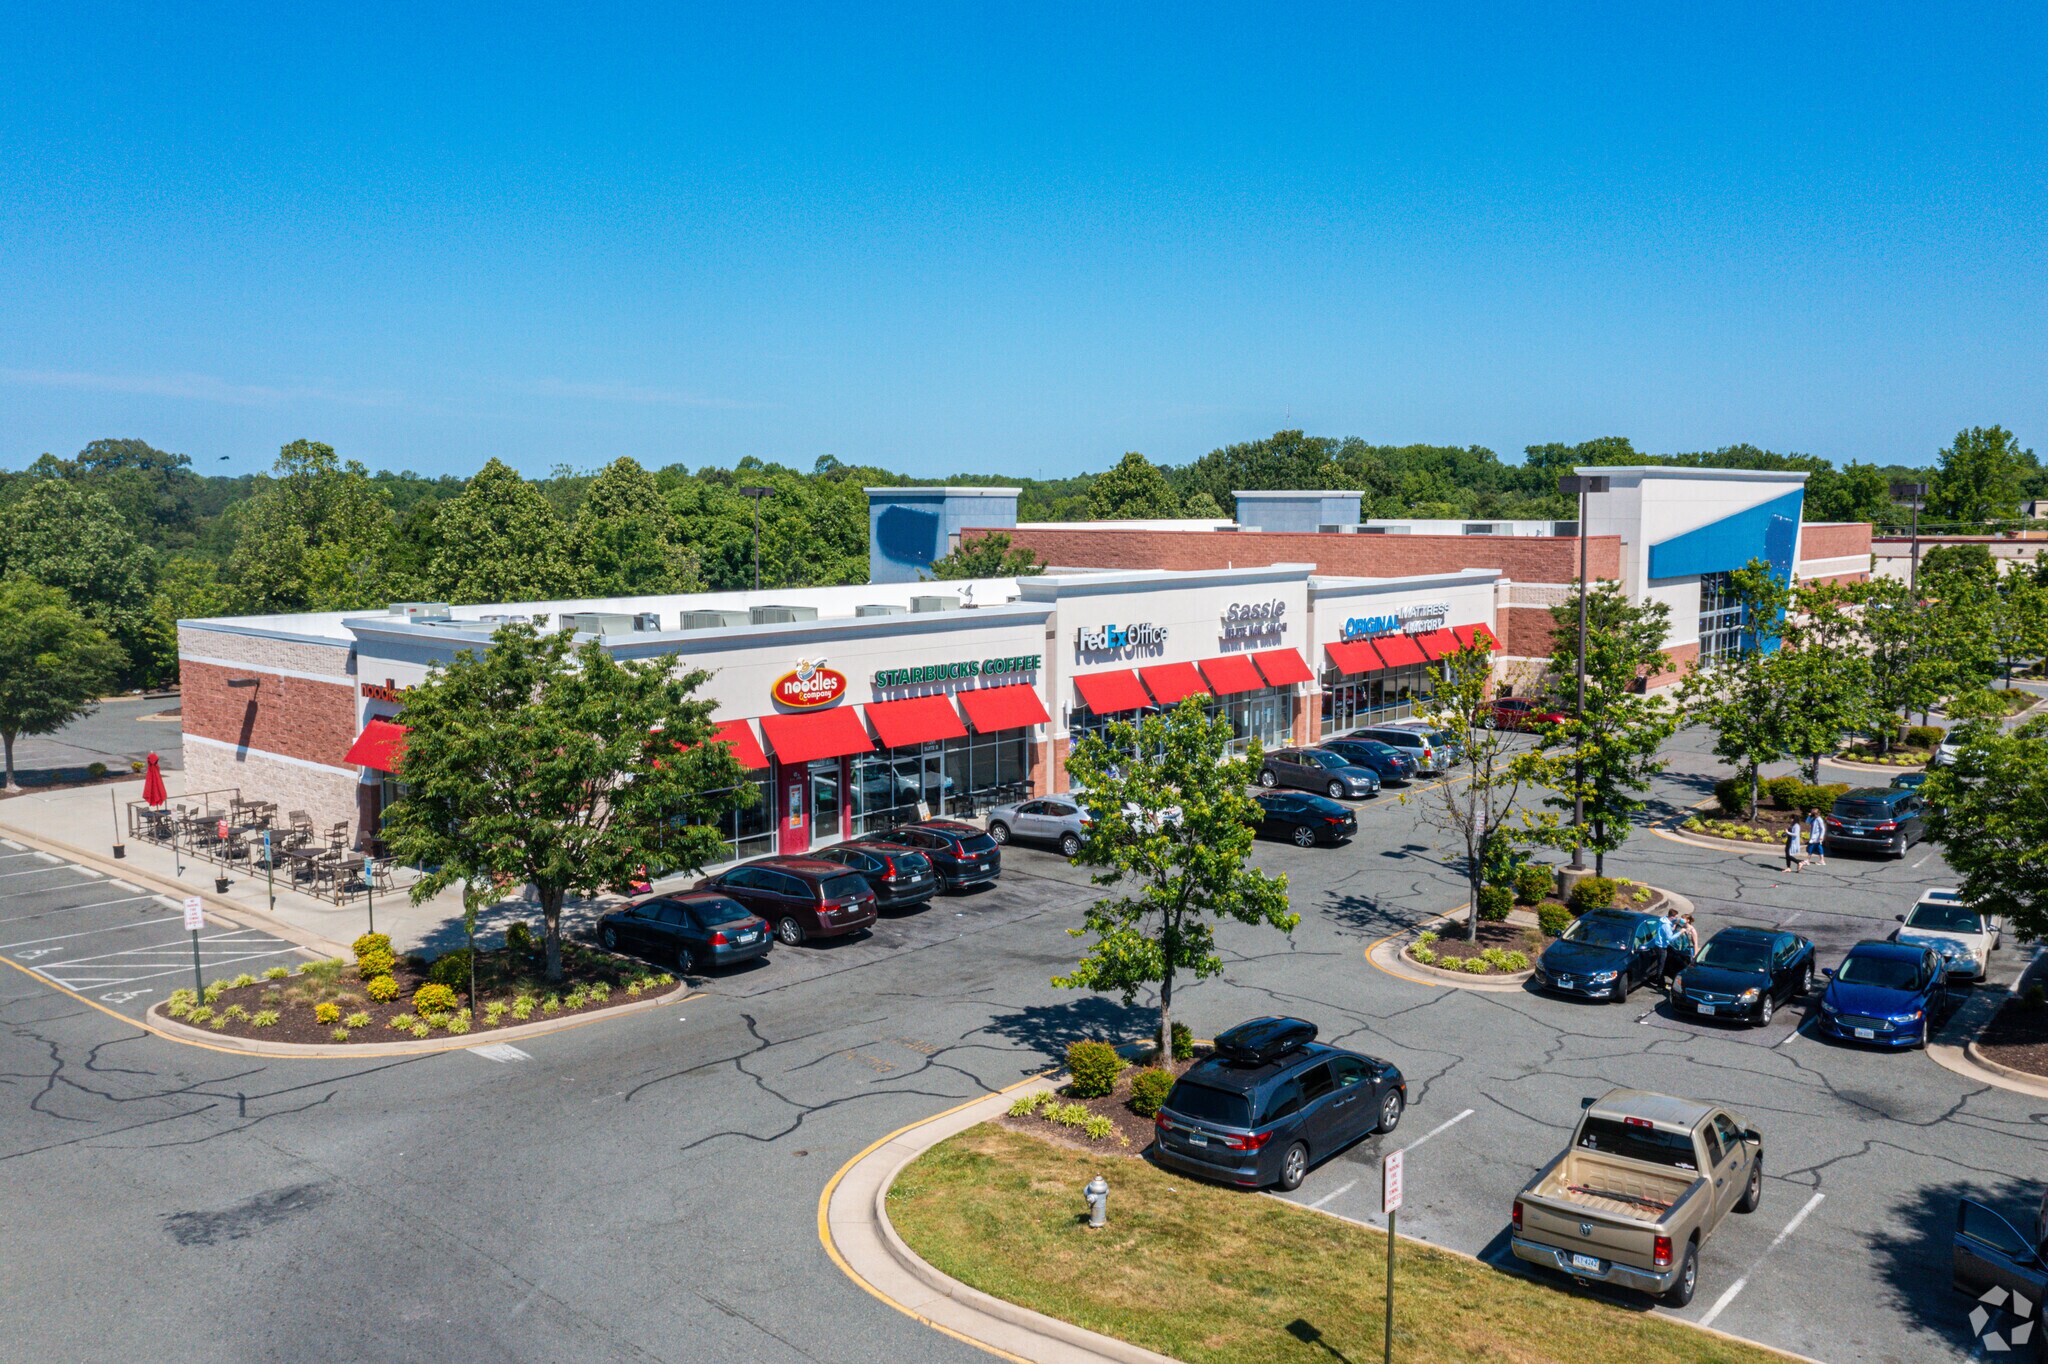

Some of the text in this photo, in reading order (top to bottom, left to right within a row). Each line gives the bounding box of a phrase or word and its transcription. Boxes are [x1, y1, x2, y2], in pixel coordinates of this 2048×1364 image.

[1226, 598, 1286, 622] Sassie
[1400, 602, 1450, 619] MATTRESS
[1078, 622, 1170, 652] FedEx Office
[1345, 614, 1402, 638] ORIGINAL
[1406, 618, 1443, 634] FACTORY
[783, 671, 838, 695] noodles
[873, 654, 1042, 689] STARBUCKS COFFEE
